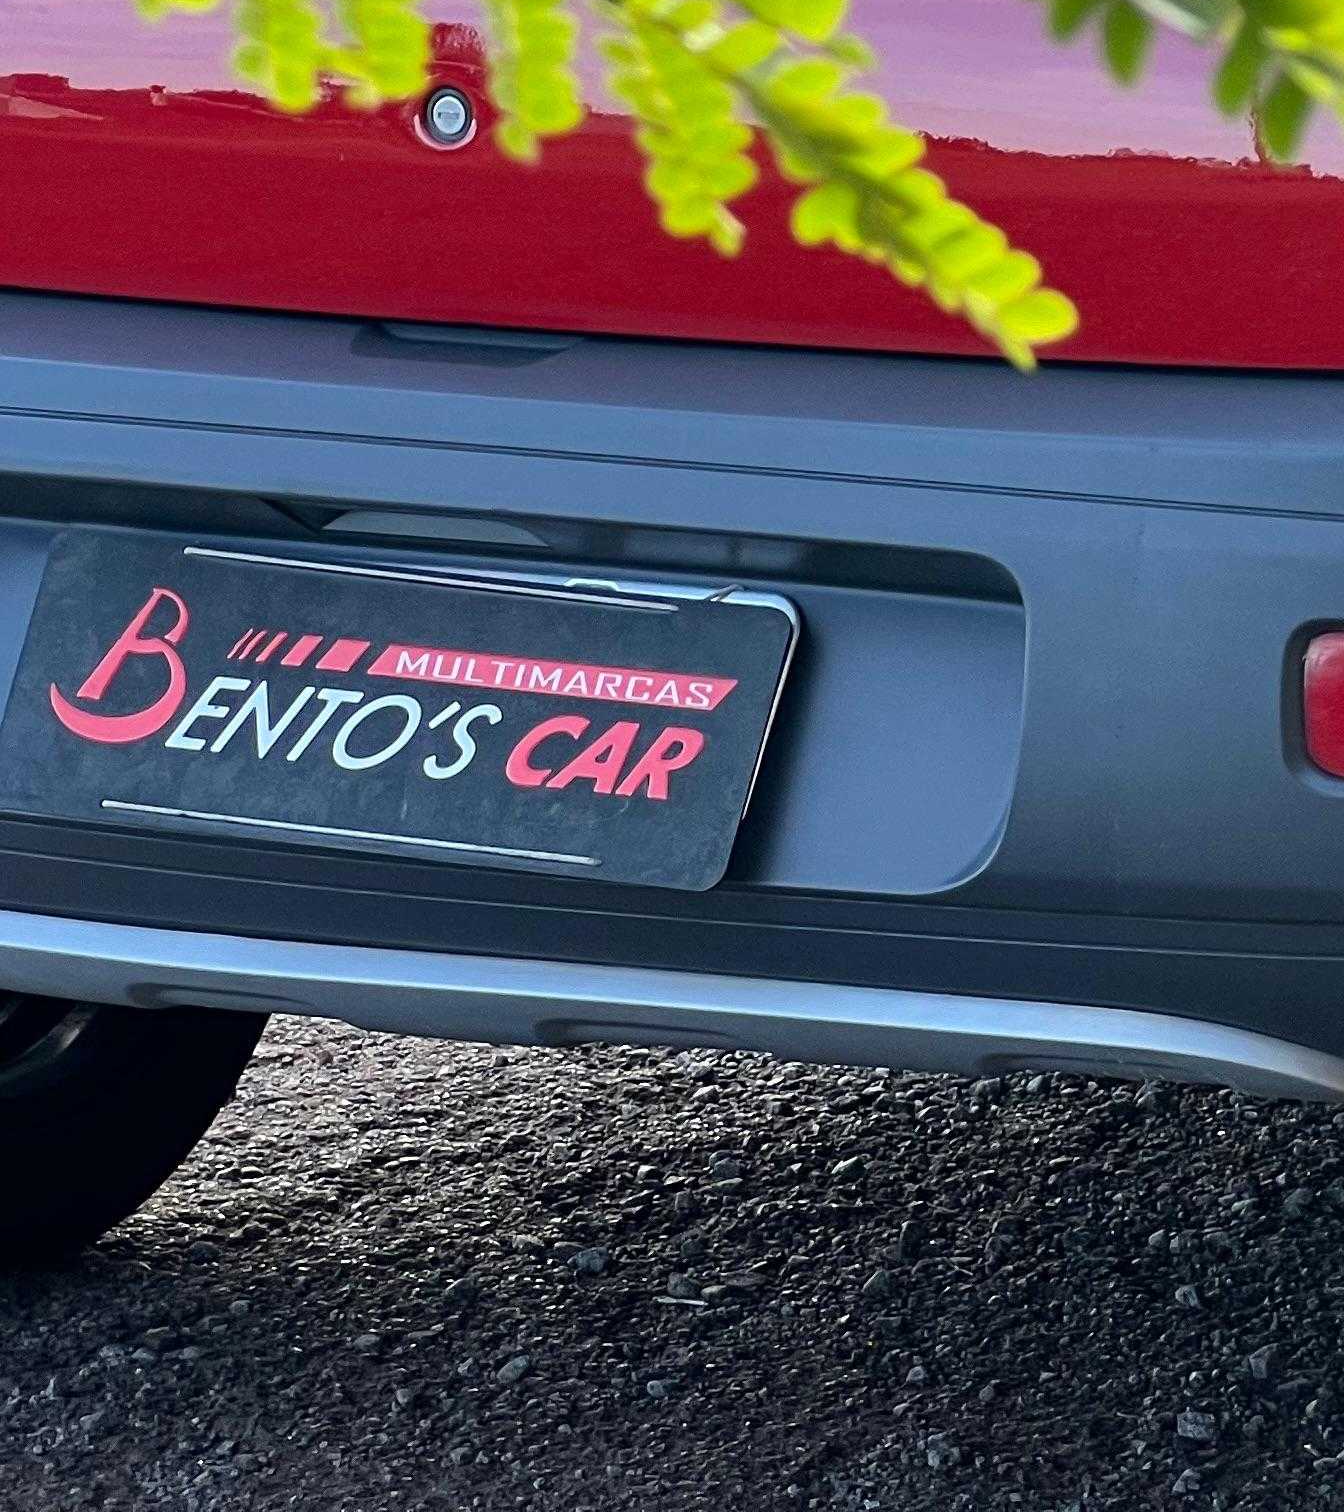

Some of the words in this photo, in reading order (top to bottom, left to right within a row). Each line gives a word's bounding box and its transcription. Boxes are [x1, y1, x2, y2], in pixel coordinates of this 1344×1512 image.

[50, 587, 502, 780] BENTO'S
[505, 715, 707, 802] CAR
[395, 650, 715, 709] MULTIMARCAS
